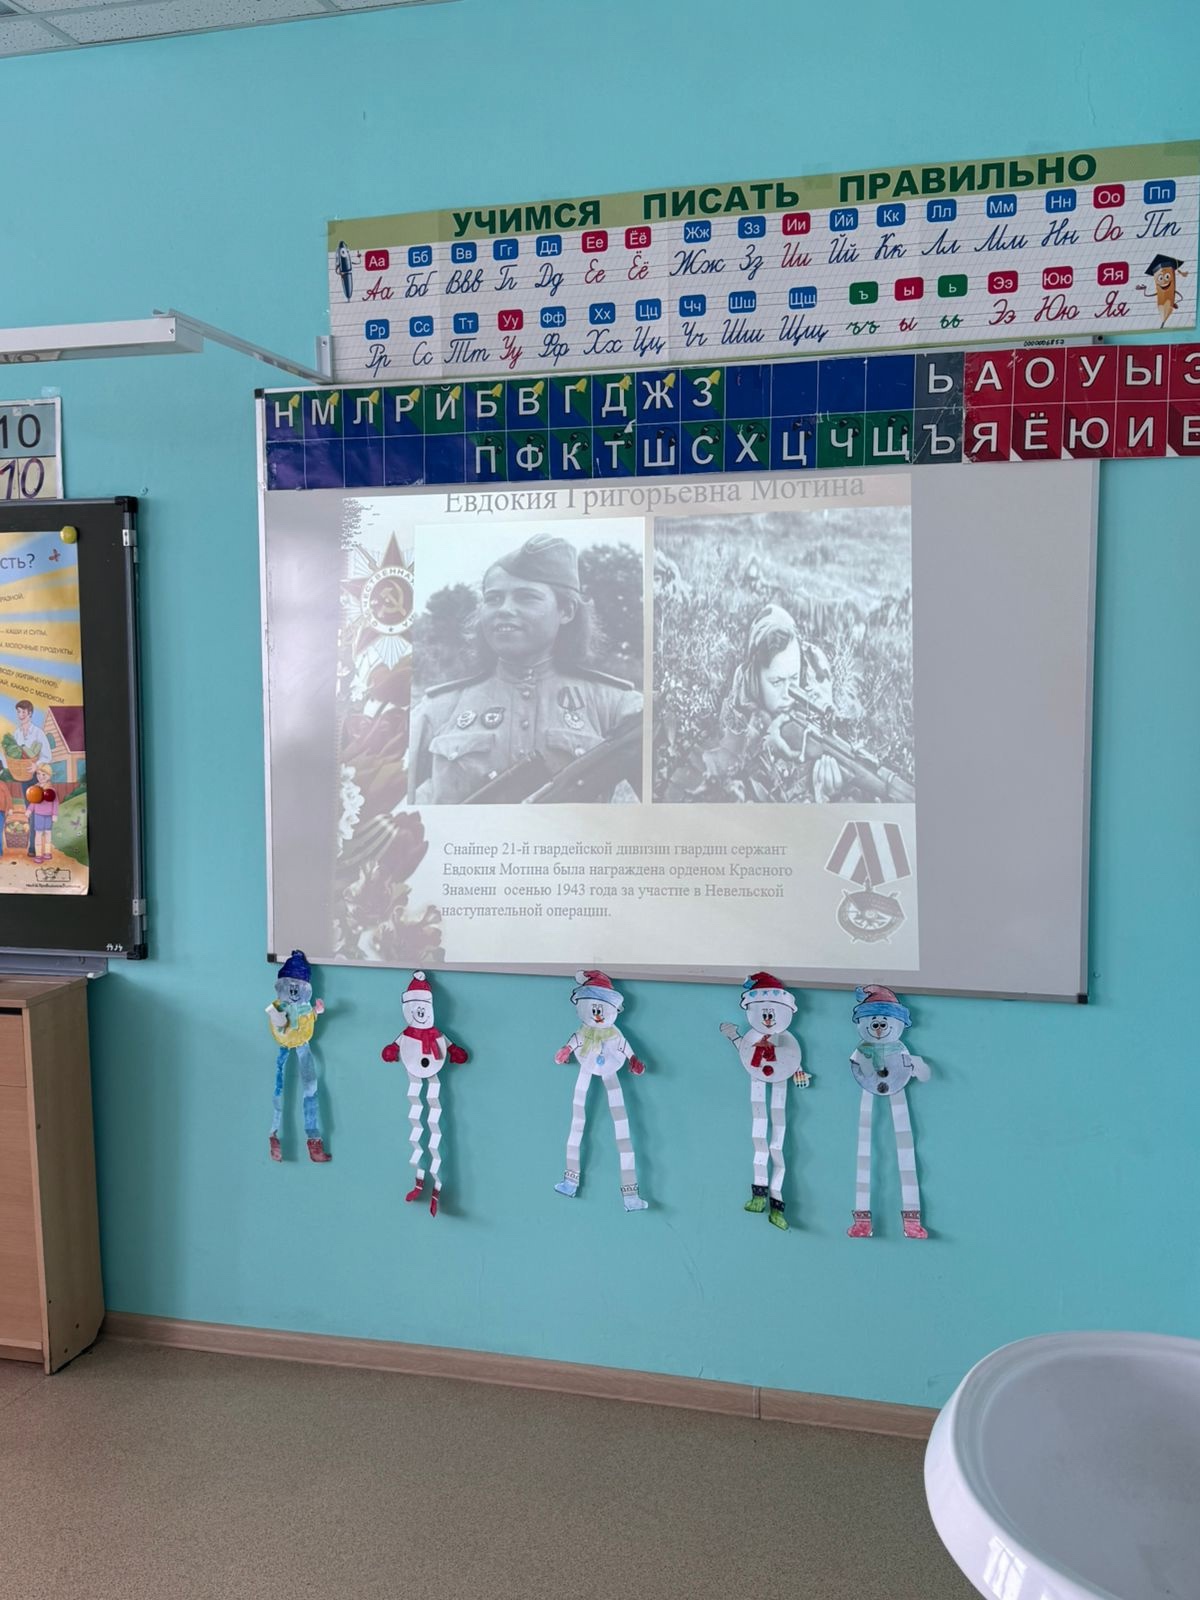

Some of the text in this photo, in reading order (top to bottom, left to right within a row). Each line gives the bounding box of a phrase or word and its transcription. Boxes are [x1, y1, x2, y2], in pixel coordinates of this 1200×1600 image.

[452, 154, 1097, 237] УЧИМСЯ ПИСАТЬ ПРАВИЛЬНО
[369, 186, 1170, 268] Аа Бб Вв Гг Дд Ее Ёё Жж Зз Ии Йй Кк Лл Мм Нн Оо Пп
[362, 276, 394, 301] Аа
[405, 270, 438, 298] Бб
[585, 258, 606, 284] Ее
[628, 250, 649, 280] Ёё
[669, 248, 726, 276] Жж
[828, 233, 860, 264] Йй
[874, 232, 907, 260] Кк
[1041, 217, 1080, 247] Нн
[1094, 214, 1124, 242] Оо
[369, 268, 1124, 338] Рр Сс Тт Уу Фф Хх Цц Чч Шш Щщ ъ ы ь Ээ Юю Яя
[412, 341, 434, 366] Сс
[499, 335, 523, 370] Уу
[537, 332, 570, 367] Фф
[583, 328, 623, 355] Хх
[988, 298, 1017, 325] Ээ
[1033, 293, 1080, 322] Юю
[1094, 290, 1130, 318] Яя
[275, 401, 294, 428] Н
[311, 399, 335, 426] М
[353, 397, 374, 425] Л
[395, 395, 415, 423] Р
[435, 385, 456, 421] Й
[476, 390, 498, 418] Б
[518, 387, 540, 416] В
[601, 383, 627, 418] Д
[642, 380, 674, 410] Ж
[692, 376, 713, 407] З
[928, 363, 954, 394] Ь
[973, 361, 1003, 392] А
[1025, 357, 1055, 389] О
[1079, 355, 1106, 388] У
[1126, 354, 1162, 386] Ы
[0, 414, 41, 448] 10
[475, 446, 496, 474] П
[515, 443, 543, 472] Ф
[562, 443, 582, 471] К
[604, 440, 626, 469] Т
[643, 438, 676, 468] Ш
[691, 436, 714, 465] С
[735, 433, 759, 463] Х
[782, 431, 807, 466] Ц
[830, 428, 854, 458] Ч
[872, 427, 911, 461] Щ
[922, 424, 955, 455] Ъ
[971, 422, 998, 454] Я
[1025, 412, 1049, 450] Ё
[1069, 417, 1109, 449] Ю
[1128, 417, 1154, 448] И
[0, 458, 45, 500] 10
[444, 490, 558, 515] Евдокия
[751, 477, 865, 501] Мотина
[442, 862, 793, 880] Евдокия Мотина была награждена орденом Красного
[443, 842, 498, 858] Снайпер
[502, 841, 530, 856] 21-й
[534, 841, 613, 858] гвардейской
[674, 845, 728, 859] гвардии
[731, 845, 788, 859] сержант
[441, 904, 543, 920] наступательной
[442, 883, 785, 900] Знамени осенью 1943 года за участие в Невельской
